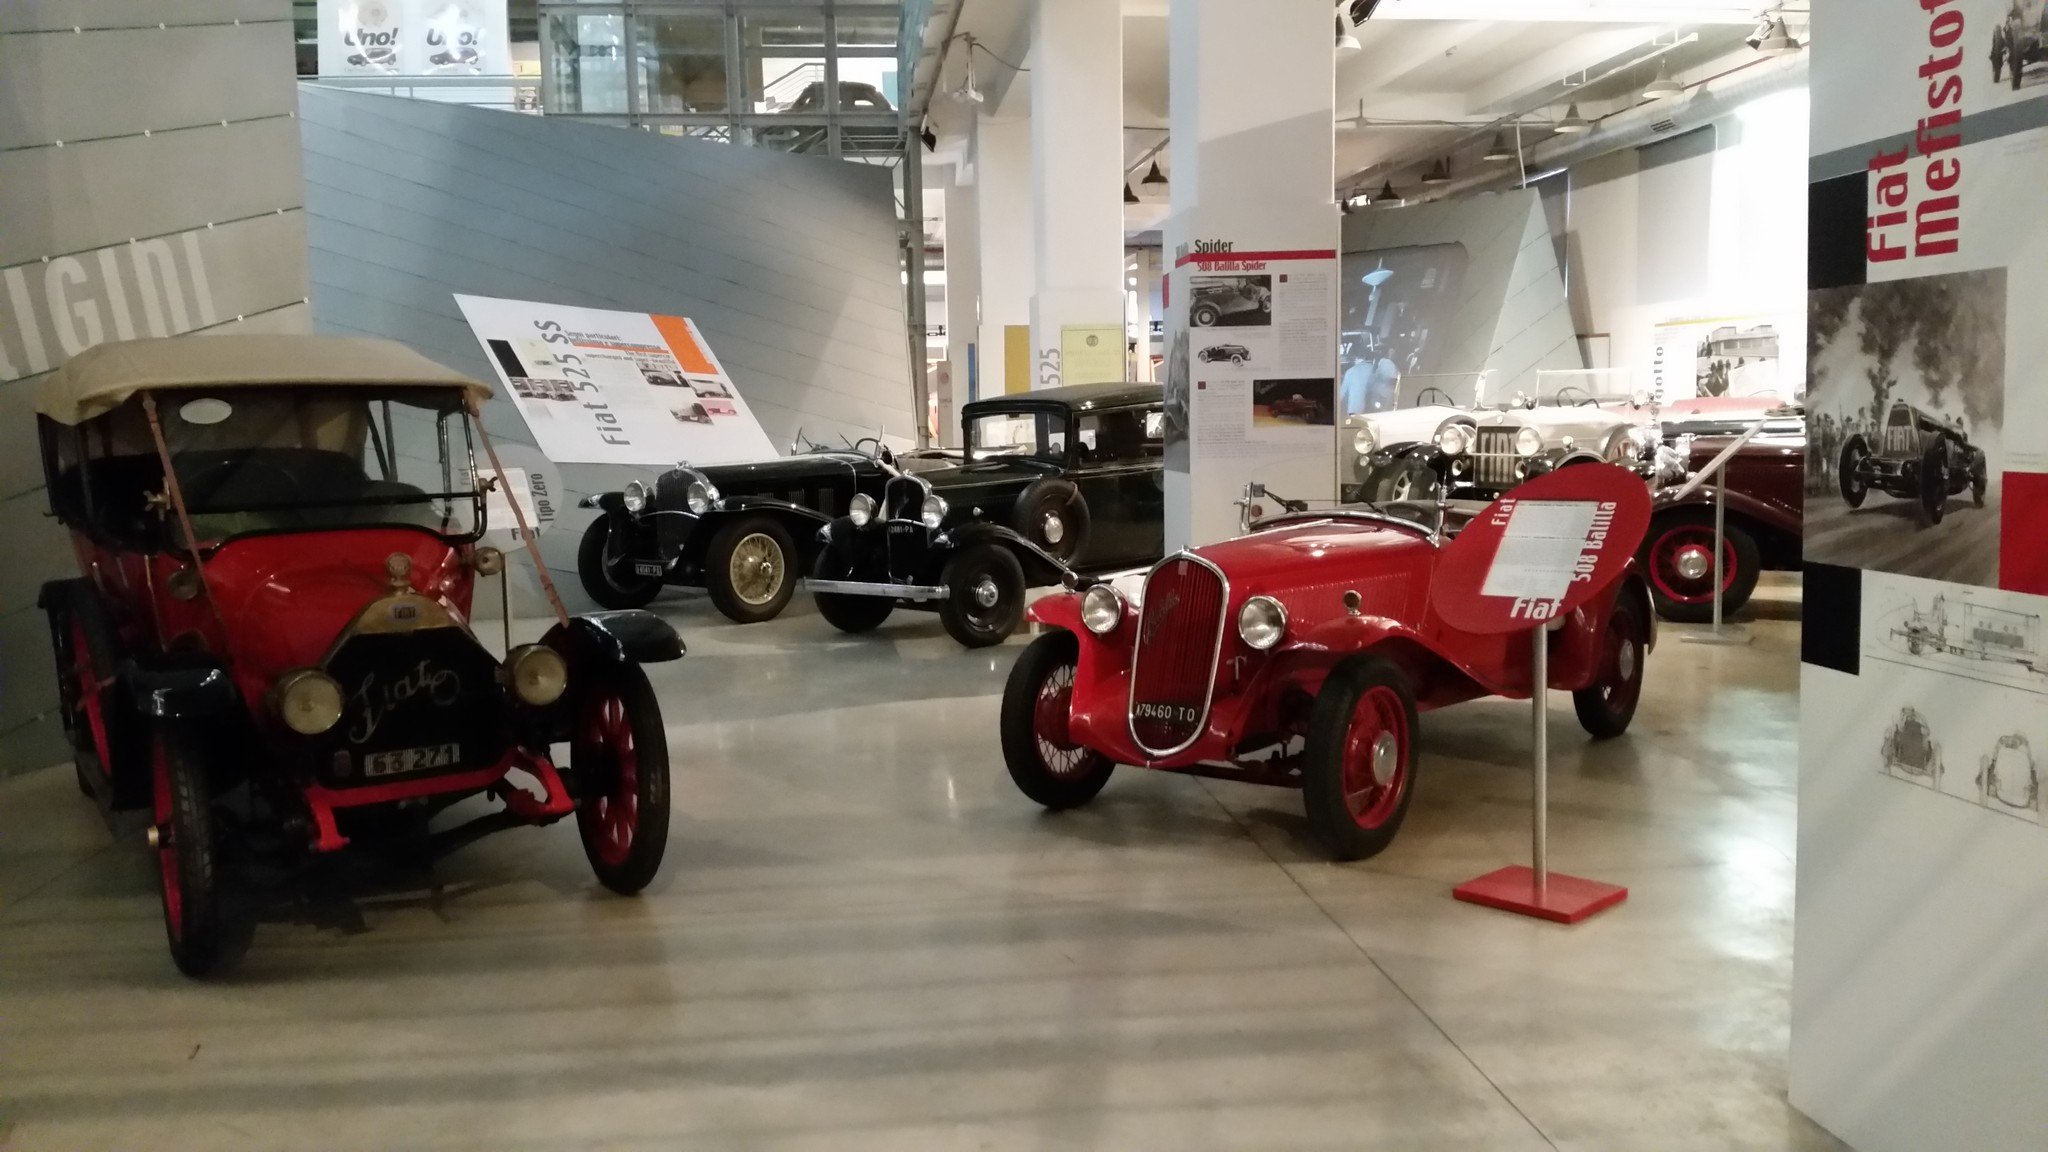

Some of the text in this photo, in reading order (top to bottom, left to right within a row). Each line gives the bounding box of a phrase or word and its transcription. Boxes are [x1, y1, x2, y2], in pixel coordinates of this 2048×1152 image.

[1866, 144, 1909, 264] Fiat
[1194, 239, 1234, 254] Spider
[1214, 261, 1240, 272] Balilla
[1241, 260, 1267, 272] Spider
[533, 320, 569, 344] SS
[552, 353, 599, 393] 525
[1039, 348, 1061, 385] 525
[582, 402, 631, 445] Fiat
[531, 473, 548, 497] Zero
[1491, 497, 1517, 526] Fiat
[1571, 501, 1617, 583] 508 Balilla
[1509, 597, 1562, 620] Fiat
